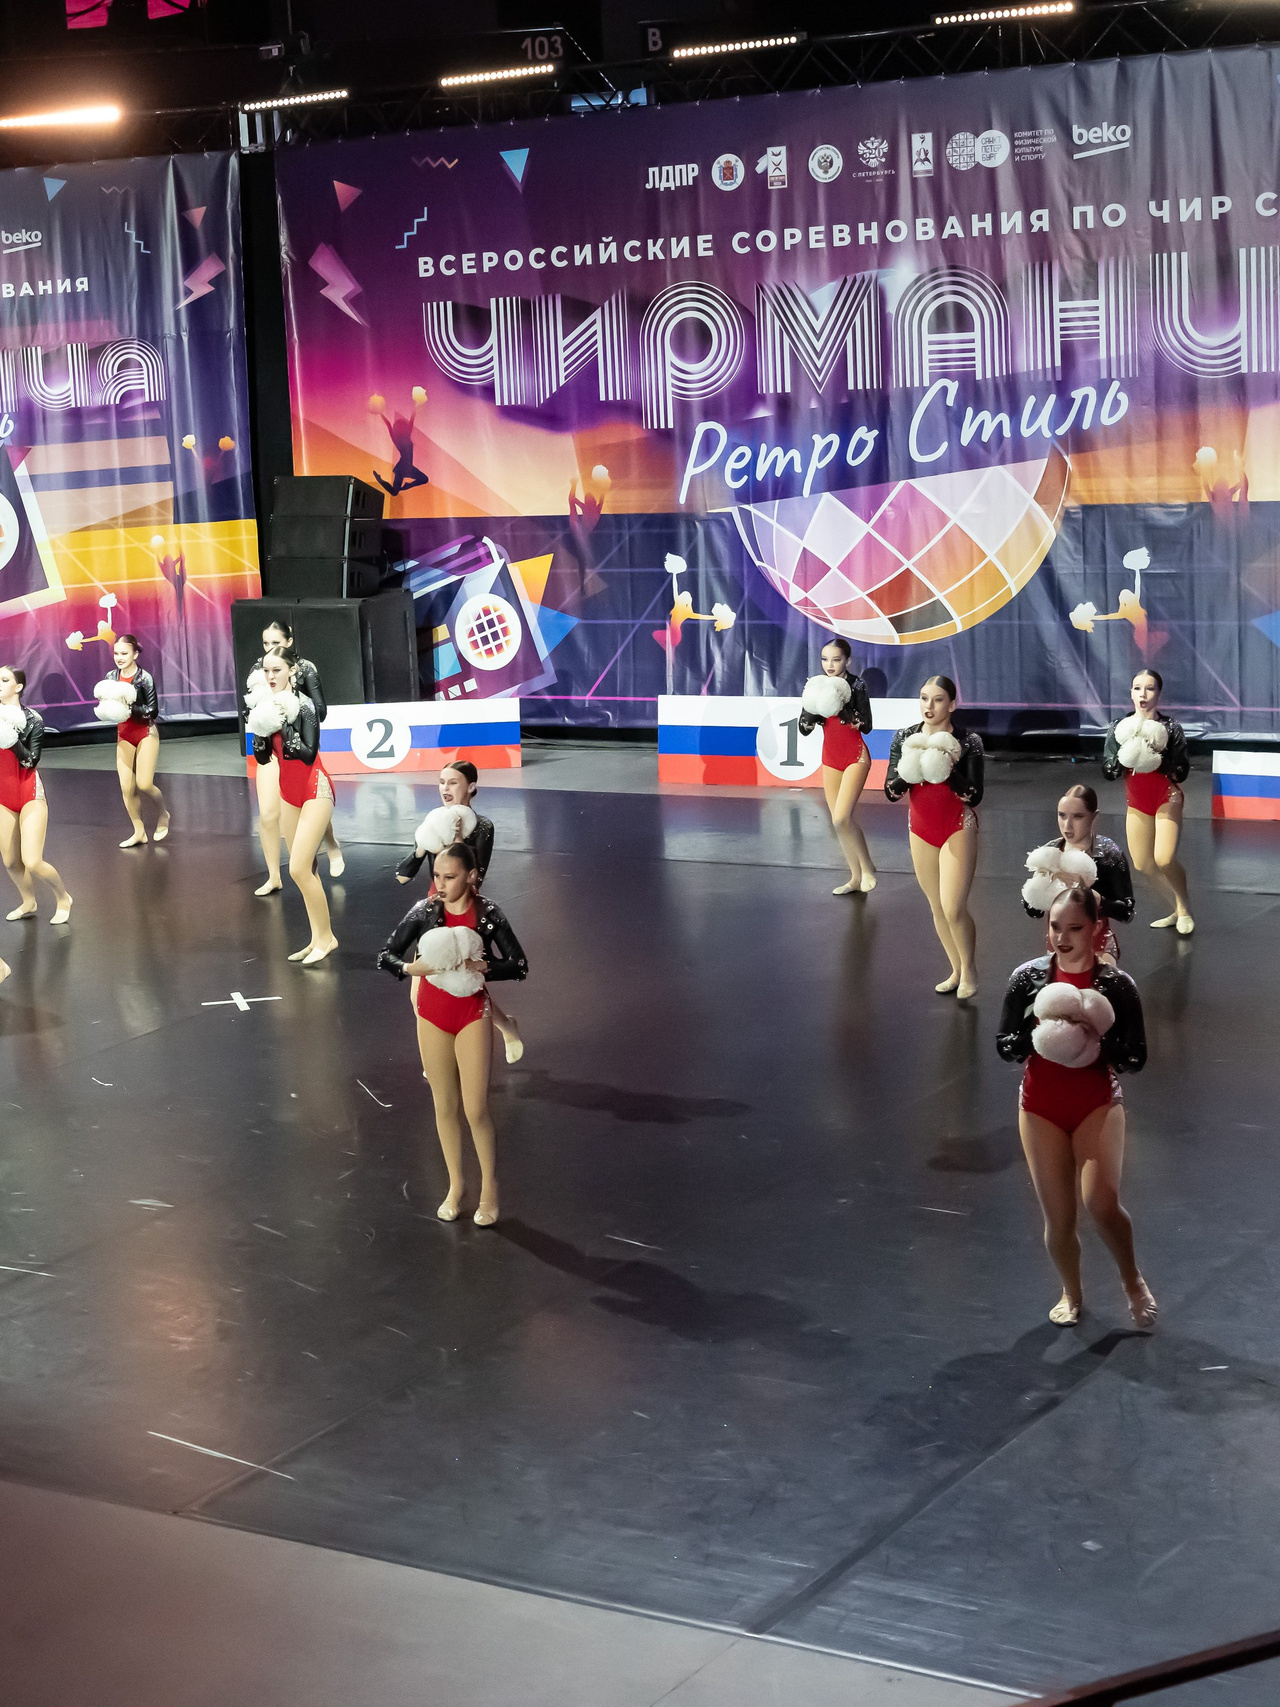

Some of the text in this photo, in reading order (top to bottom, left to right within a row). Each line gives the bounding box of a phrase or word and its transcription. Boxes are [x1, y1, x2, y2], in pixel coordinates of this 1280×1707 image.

[521, 36, 564, 60] 103
[1014, 128, 1055, 138] КОМИТЕТ ПО
[1014, 135, 1057, 145] ФИЗИЧЕСКОЙ
[1072, 121, 1132, 146] beko
[1020, 153, 1046, 161] СПОРТУ
[645, 163, 699, 192] ЛДПР
[0, 228, 42, 245] beko
[418, 234, 714, 278] ВСЕРОССИЙСКИЕ
[731, 208, 1050, 254] СОРЕВНОВАНИЯ
[1072, 203, 1127, 230] ПО
[1148, 195, 1233, 224] ЧИР
[677, 377, 1129, 505] Ретро Стиль
[366, 718, 396, 759] 2
[778, 717, 805, 767] 1
